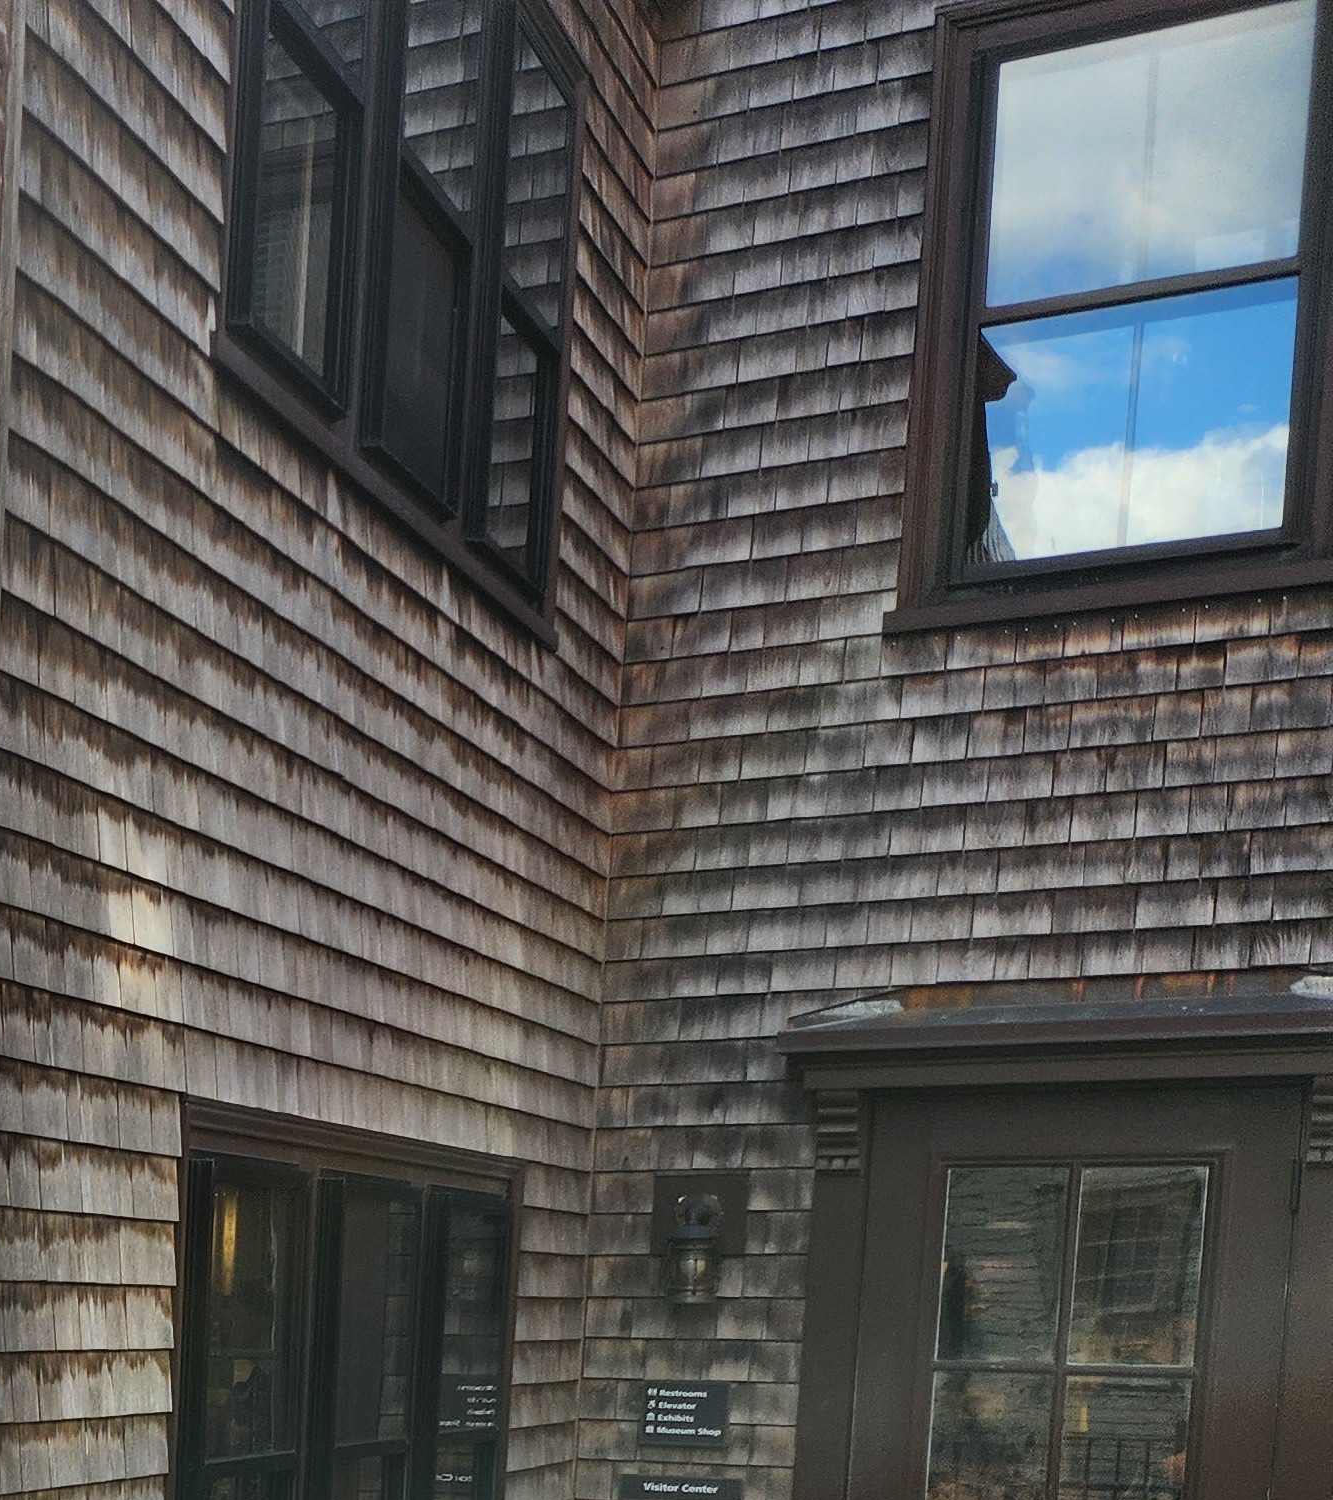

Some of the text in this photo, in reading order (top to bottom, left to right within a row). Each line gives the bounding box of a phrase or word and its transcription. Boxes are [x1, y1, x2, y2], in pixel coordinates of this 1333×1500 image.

[659, 1389, 707, 1398] Restrooms
[658, 1401, 697, 1410] Elevator
[657, 1413, 695, 1423] Exhibits
[656, 1425, 721, 1437] Museum Shop
[643, 1482, 719, 1494] Visitor Center
